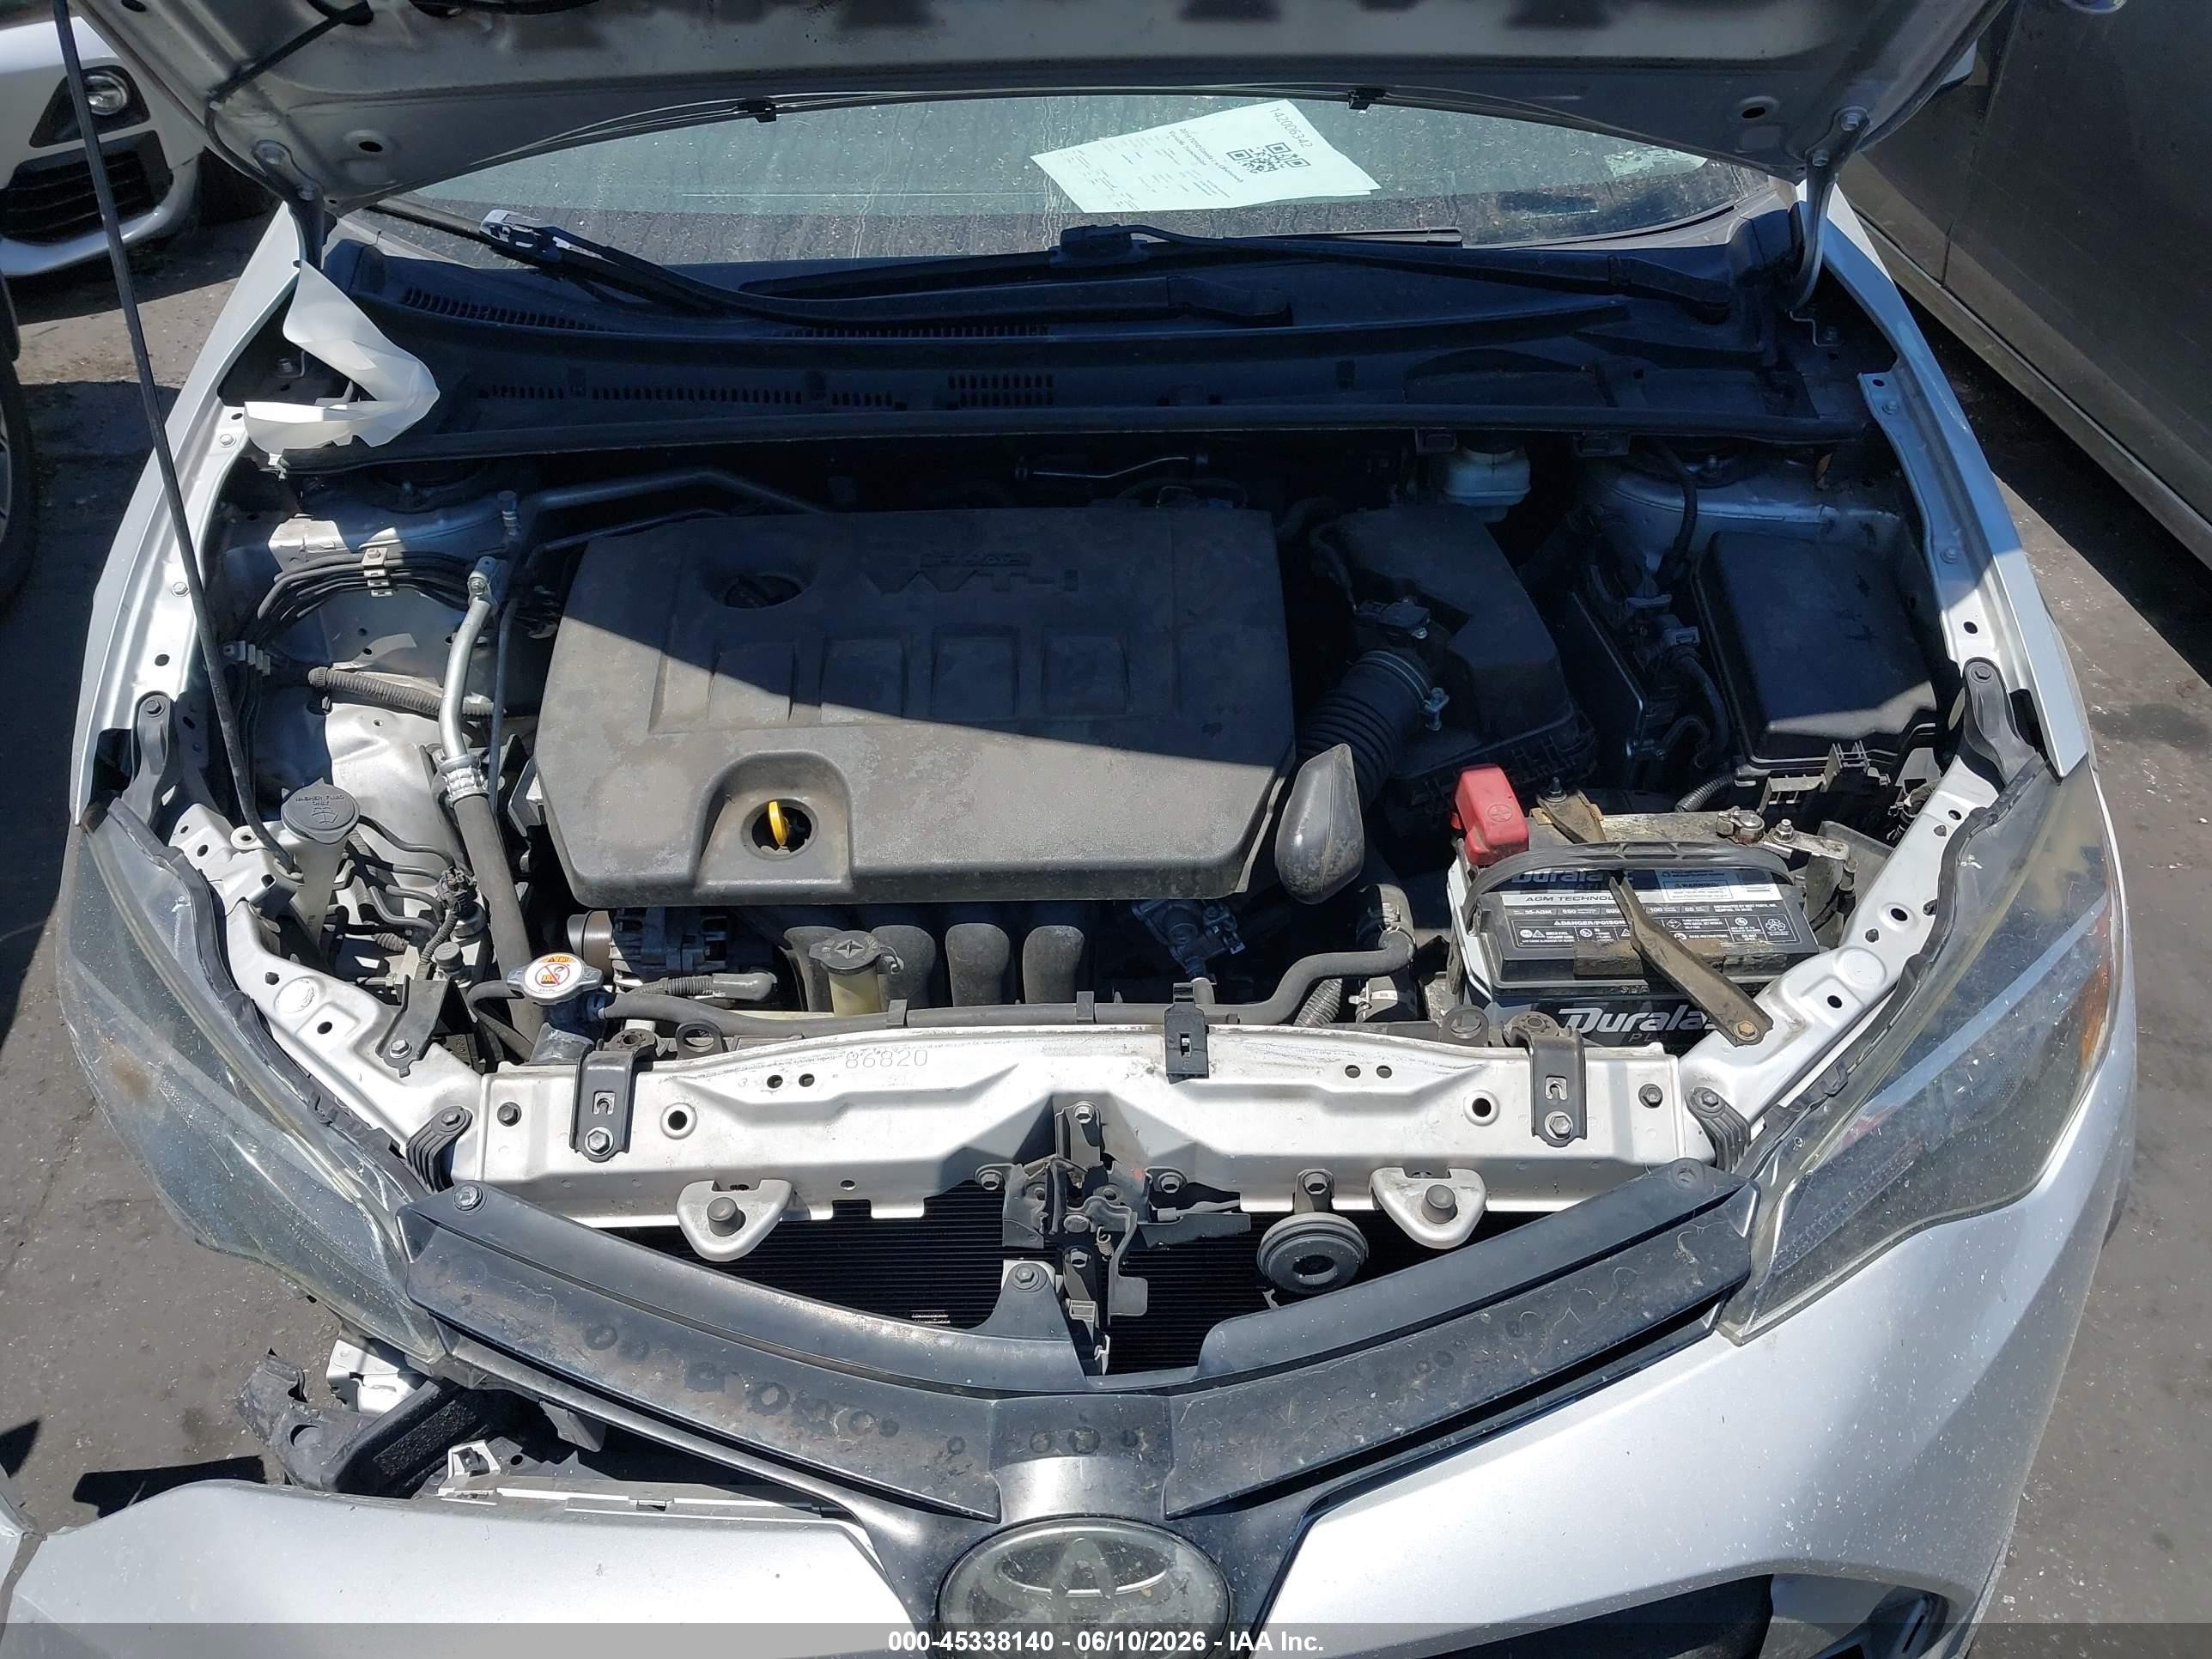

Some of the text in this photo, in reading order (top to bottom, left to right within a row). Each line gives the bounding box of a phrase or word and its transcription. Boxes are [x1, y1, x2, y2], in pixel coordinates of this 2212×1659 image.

[1268, 107, 1314, 149] 142006342
[1559, 1006, 1718, 1034] Durala
[845, 1049, 927, 1069] 86820
